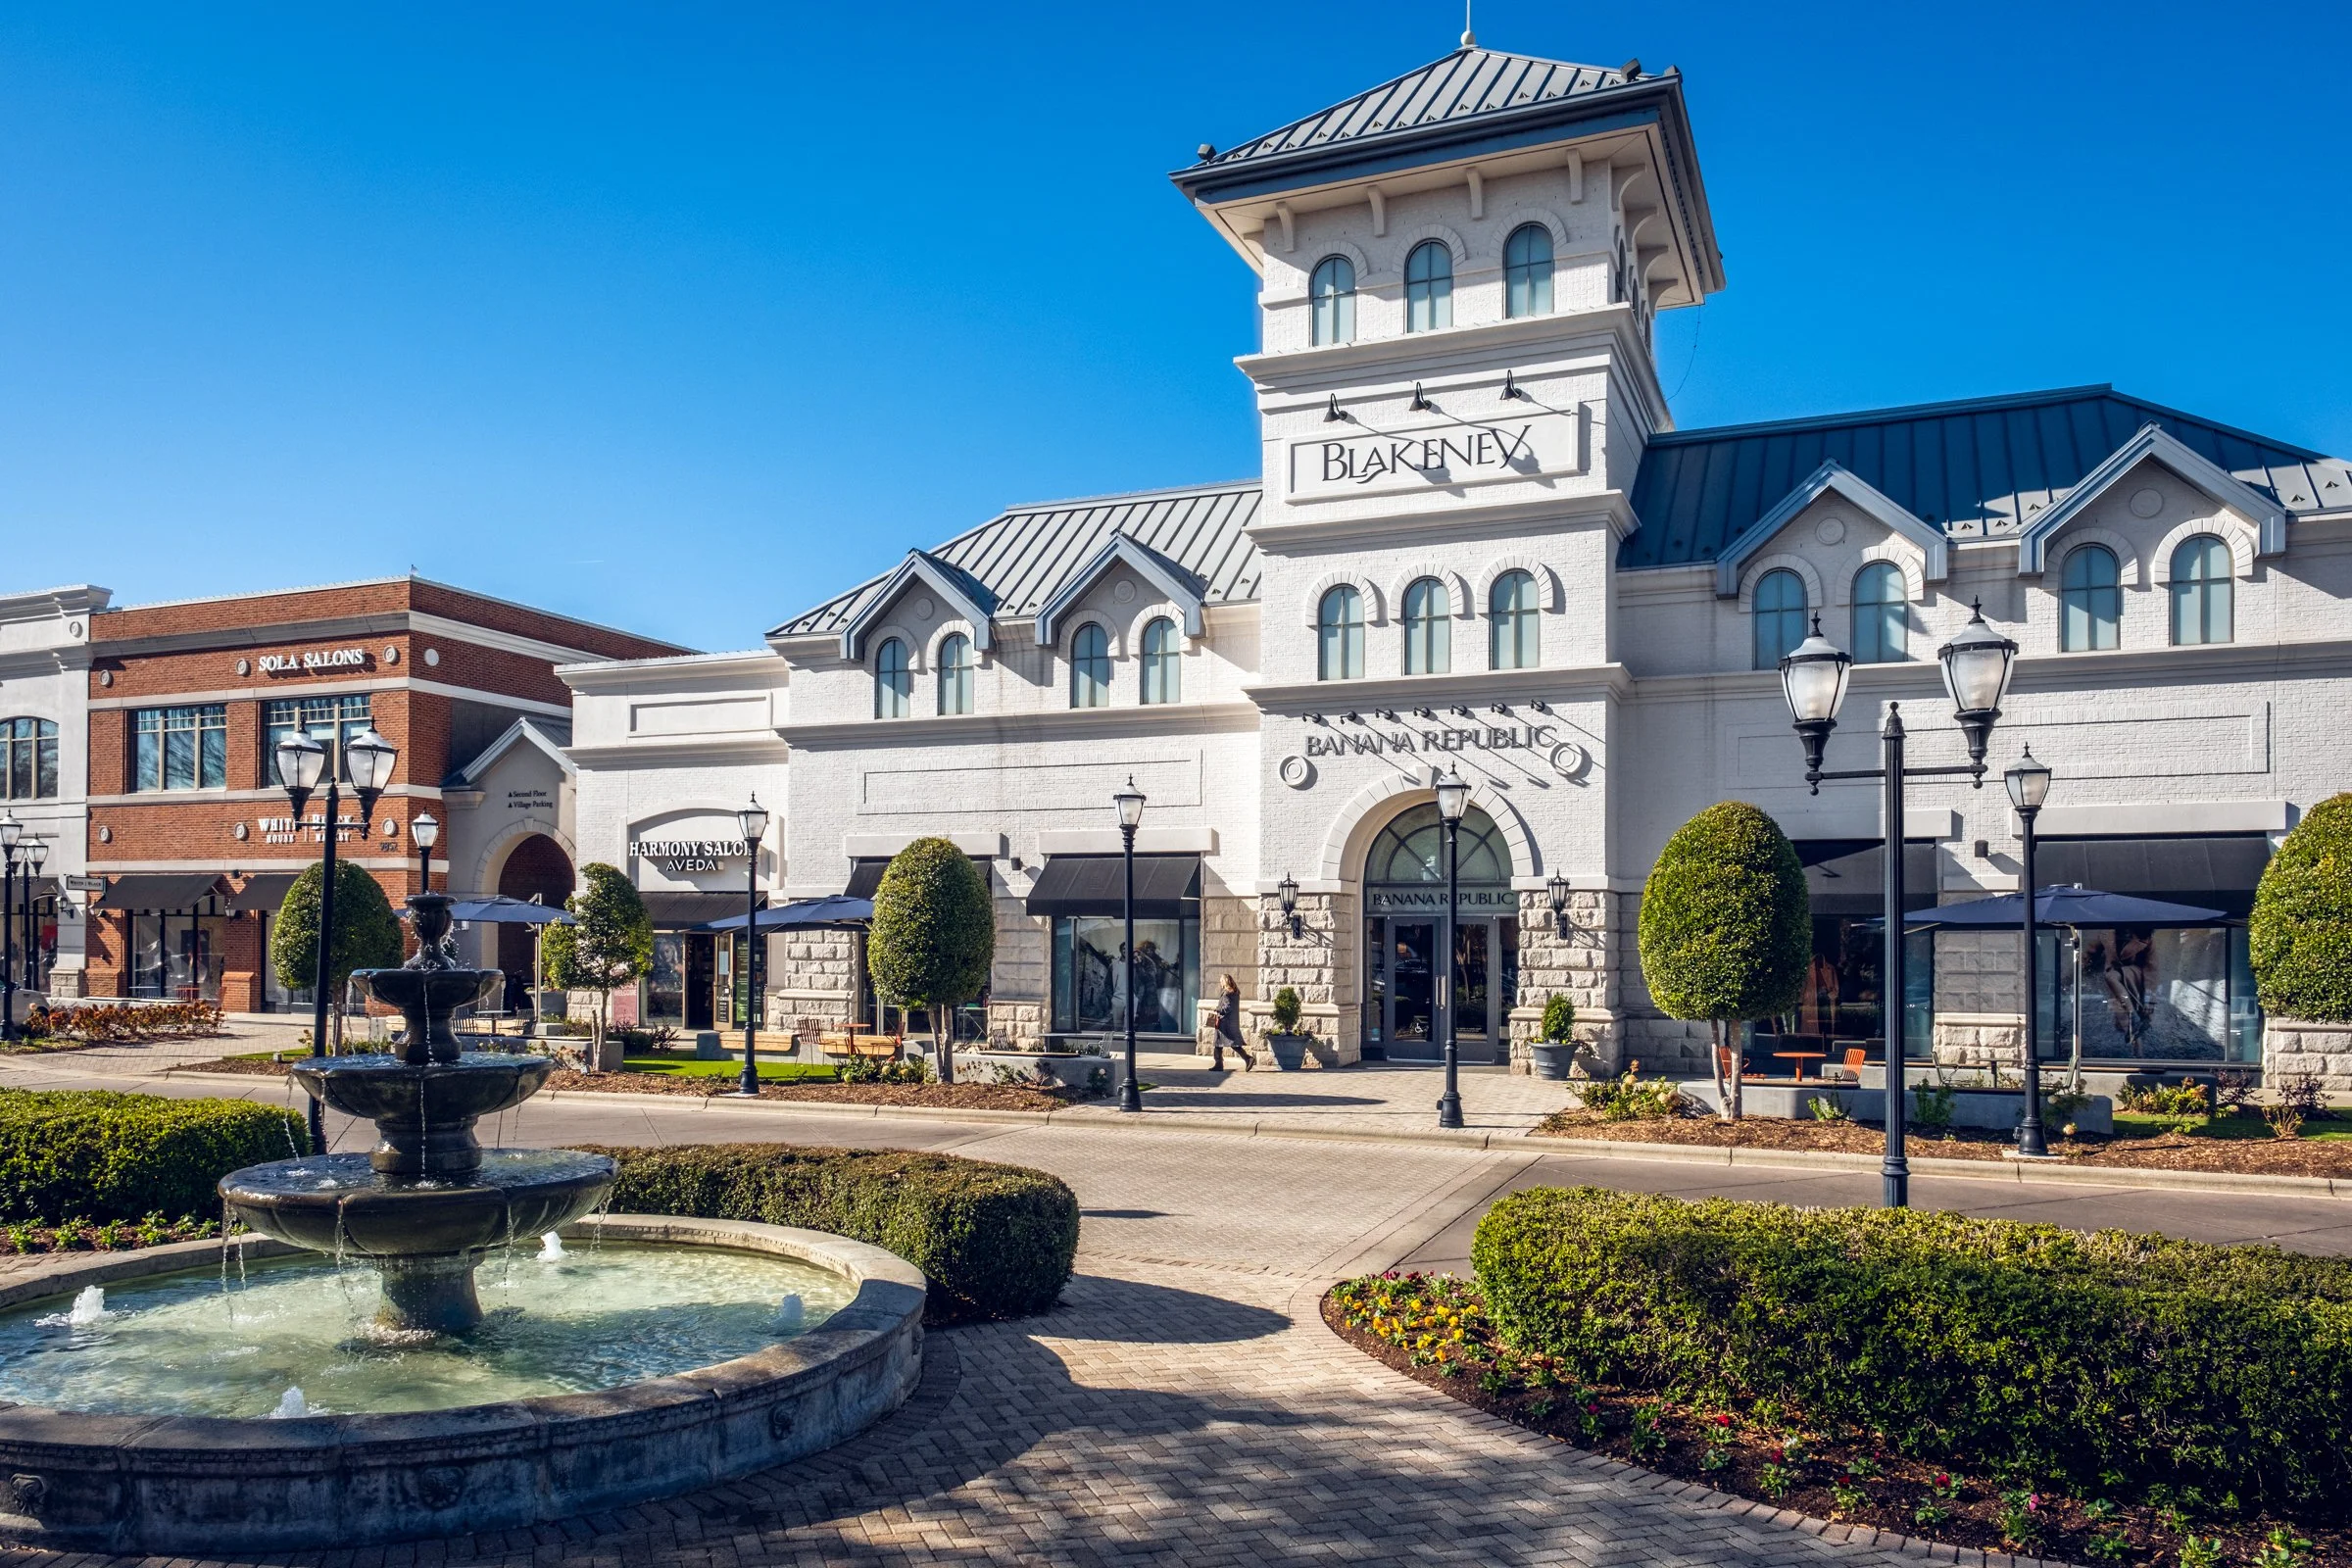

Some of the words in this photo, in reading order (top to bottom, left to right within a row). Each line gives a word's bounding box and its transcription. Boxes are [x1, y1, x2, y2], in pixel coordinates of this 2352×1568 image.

[1322, 424, 1533, 484] BLAKENEY
[259, 654, 301, 671] SOLA
[304, 649, 365, 668] SALONS
[1306, 731, 1417, 757] BANANA
[1421, 724, 1557, 753] REPUBLIC
[267, 833, 295, 844] HOUSE
[629, 841, 700, 857] HARMONY
[666, 858, 716, 871] AVEDA
[1373, 893, 1436, 906] BANANA
[1440, 892, 1514, 906] RPUBLIC
